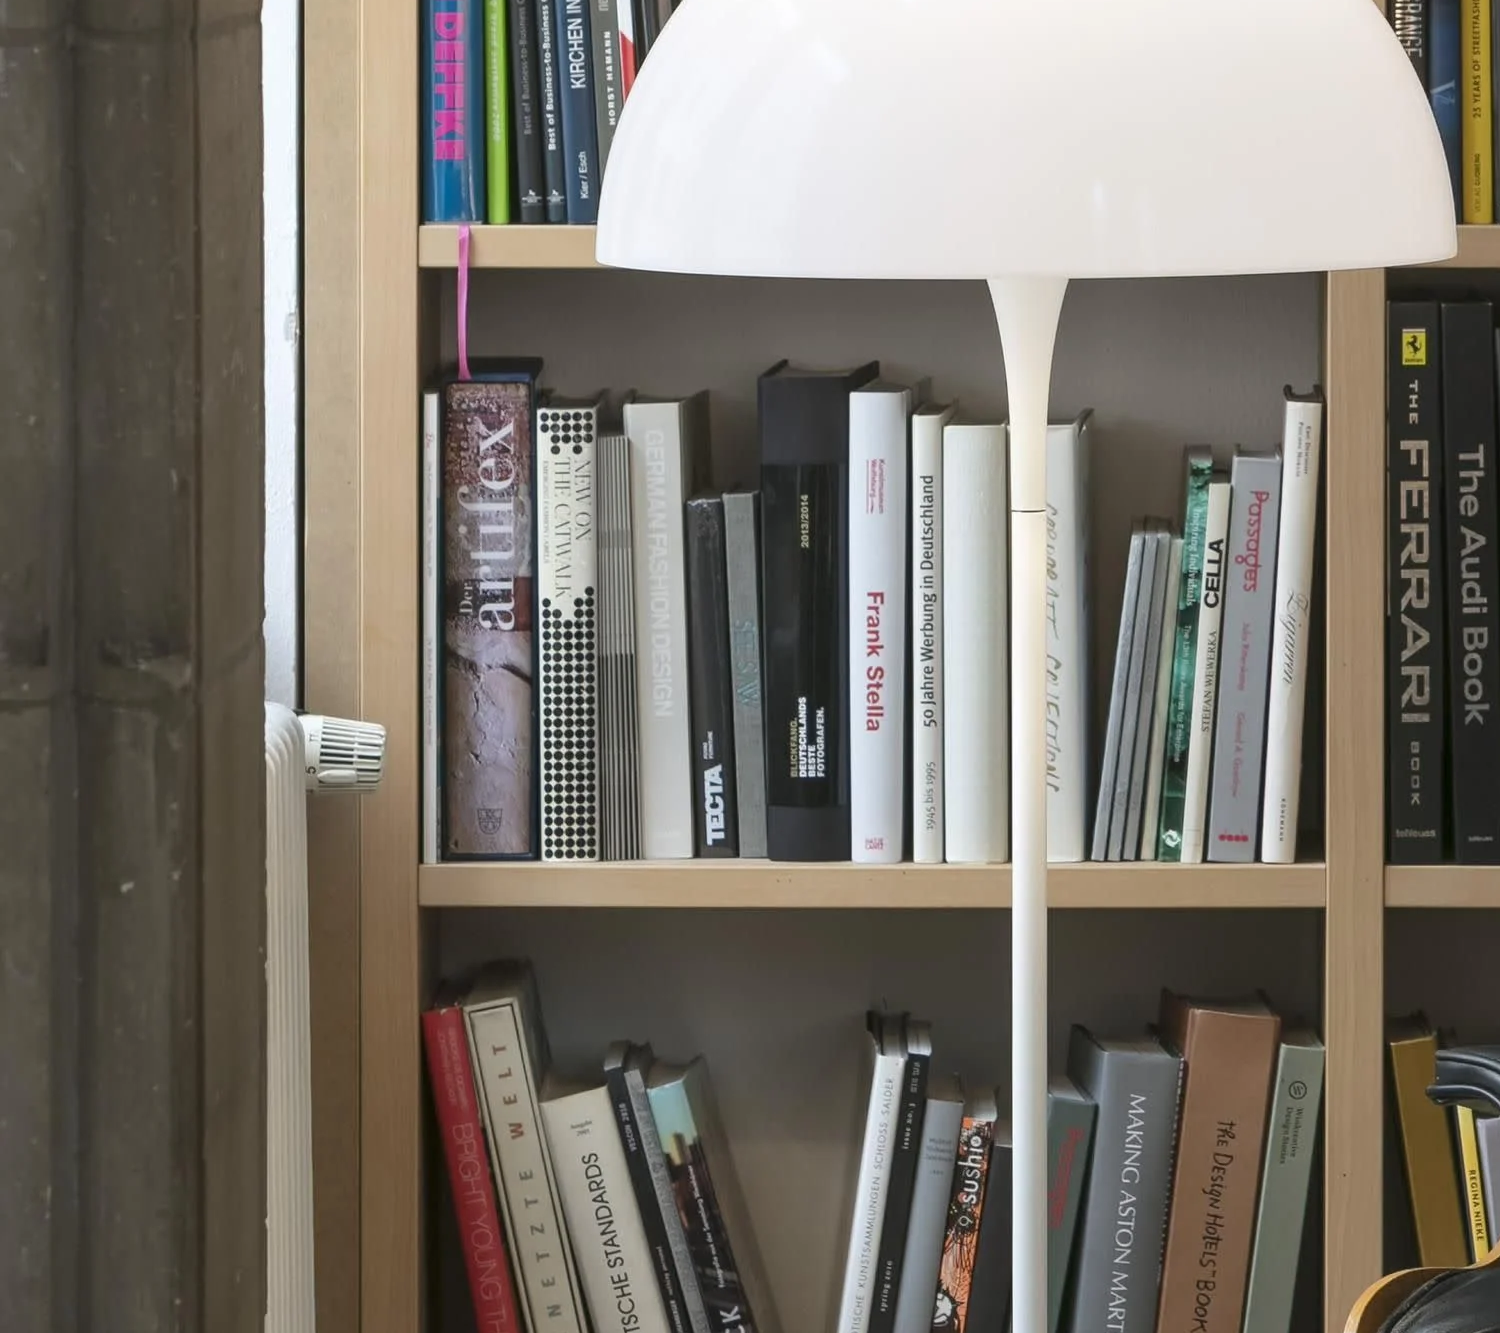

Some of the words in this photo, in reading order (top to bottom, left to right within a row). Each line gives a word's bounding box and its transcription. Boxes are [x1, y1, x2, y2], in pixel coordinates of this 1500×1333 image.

[566, 0, 582, 14] IN
[567, 18, 586, 89] KIRCHEN
[1472, 60, 1480, 72] OF
[1472, 75, 1480, 103] YEARS
[1472, 107, 1481, 118] 25
[1457, 443, 1485, 518] The
[801, 494, 809, 549] 2013/2014
[919, 475, 934, 572] Deutschland
[920, 576, 934, 589] in
[1204, 537, 1224, 609] CELLA
[1400, 440, 1431, 723] FERRARI
[1460, 526, 1487, 614] Audi
[866, 591, 885, 657] Frank
[920, 593, 937, 661] Werbung
[866, 665, 885, 732] Stella
[921, 665, 936, 704] Jahre
[1462, 626, 1490, 726] Book
[798, 696, 807, 778] DEUTSCHLANDS
[816, 707, 825, 778] FOTOGRAFEN.
[923, 708, 936, 728] 50
[807, 743, 816, 778] BESTE
[706, 764, 725, 846] TECTA
[1120, 1093, 1146, 1184] MAKING
[581, 1152, 624, 1267] STANDARDS
[1114, 1190, 1136, 1265] ASTON
[1469, 1170, 1479, 1207] REGINA
[1474, 1210, 1484, 1241] NIEKE
